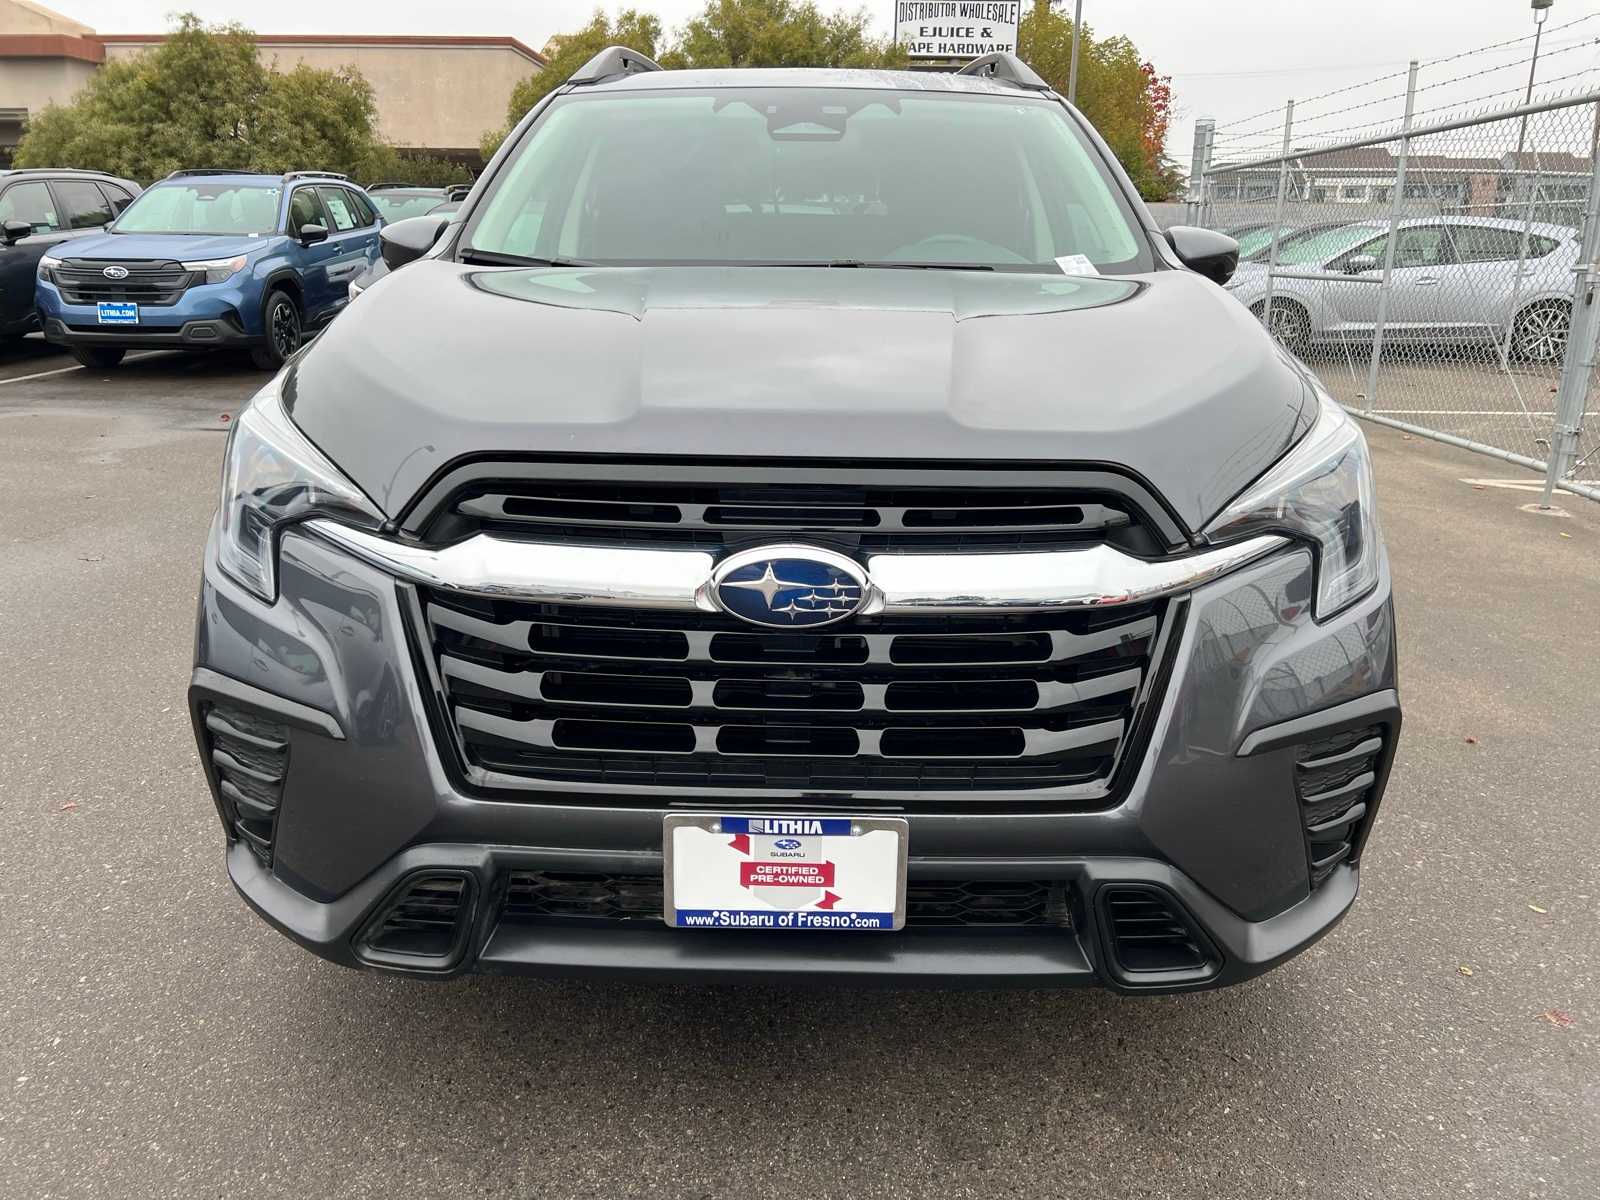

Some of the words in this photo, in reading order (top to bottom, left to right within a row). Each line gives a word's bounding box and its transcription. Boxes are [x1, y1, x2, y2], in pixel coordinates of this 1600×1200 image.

[899, 2, 957, 23] DISTRIBUTOR
[960, 3, 1017, 25] WHOLESALE
[919, 26, 975, 38] EJUICE
[980, 27, 993, 38] &
[938, 43, 1013, 54] HARDWARE
[101, 309, 135, 317] LITHIA.COM
[763, 820, 823, 835] LITHIA
[756, 865, 819, 875] CERTIFIED
[750, 874, 825, 884] PRE-OWNED
[778, 912, 793, 927] of
